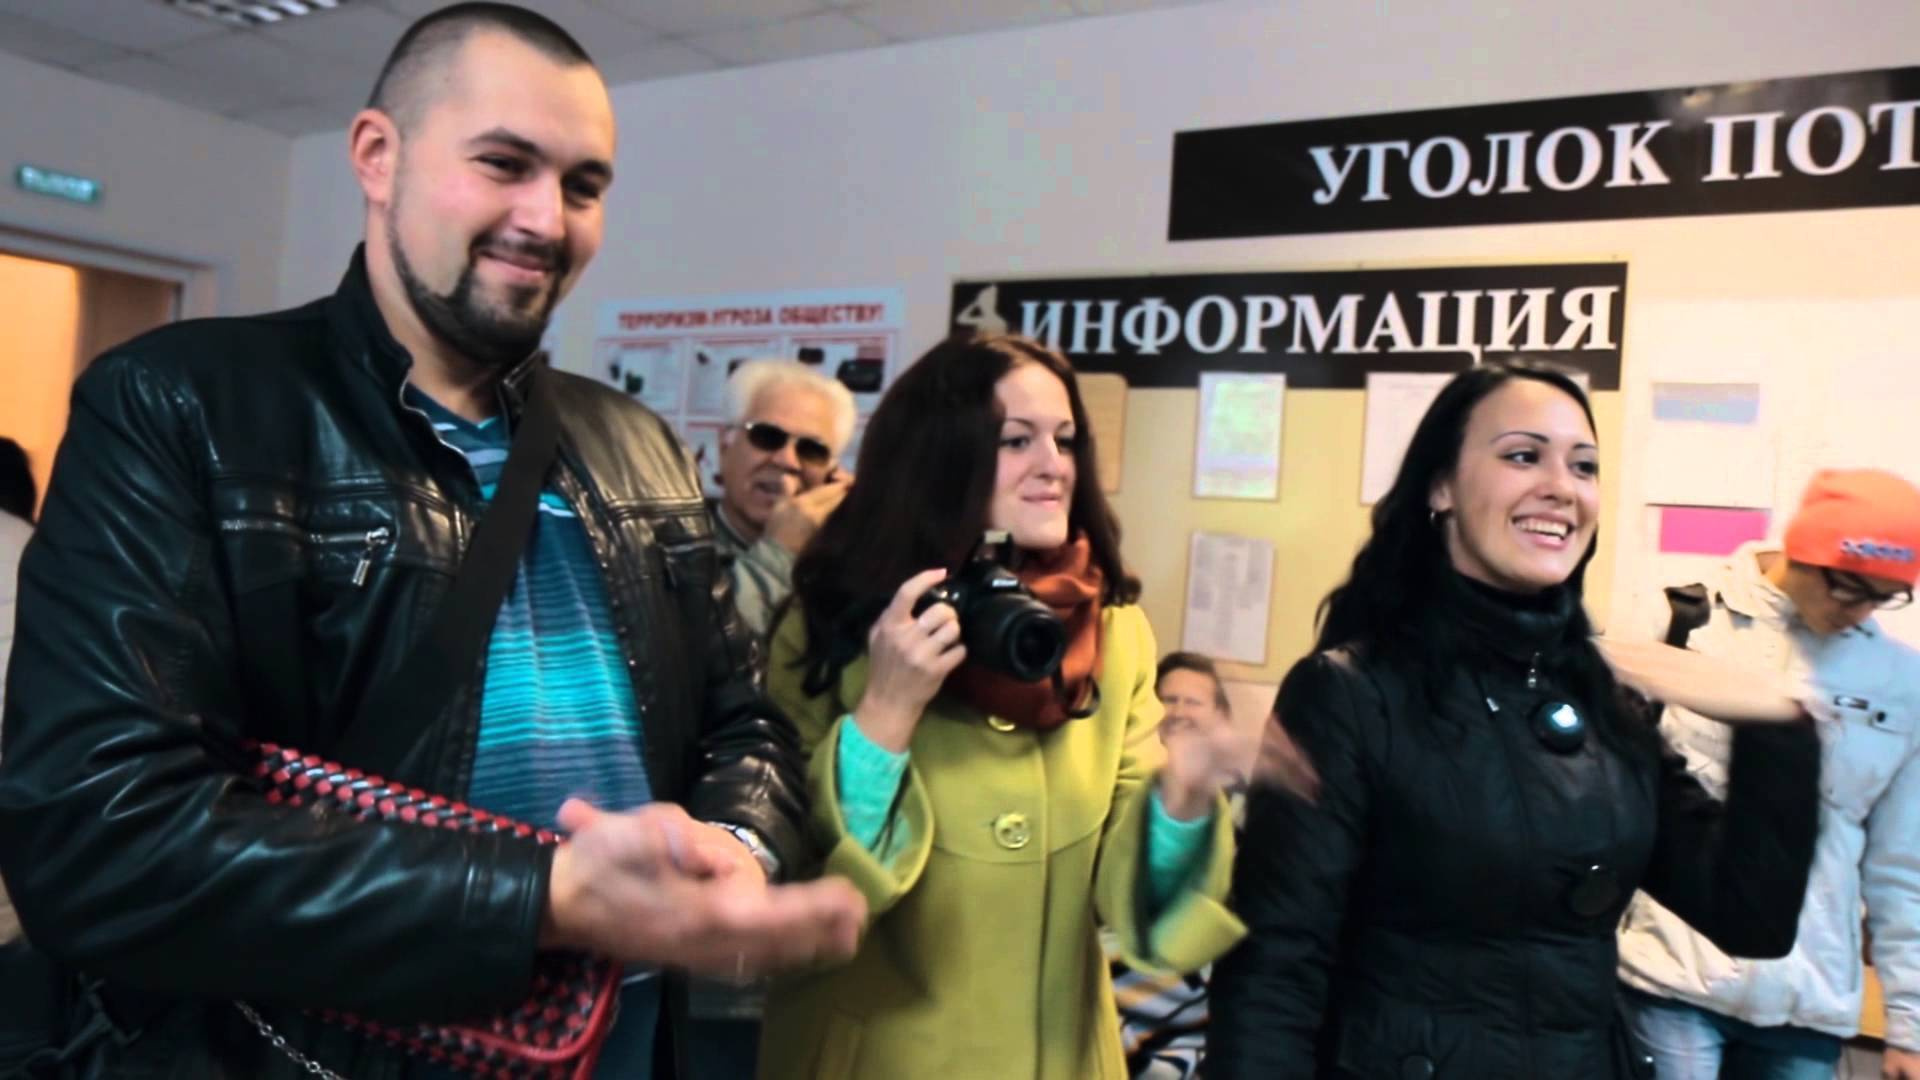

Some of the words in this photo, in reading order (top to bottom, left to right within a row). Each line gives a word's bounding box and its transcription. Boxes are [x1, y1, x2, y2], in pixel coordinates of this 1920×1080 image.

[1309, 119, 1672, 205] УГОЛОК
[1702, 99, 1920, 182] ПОТ
[1019, 285, 1620, 366] ИНФОРМАЦИЯ
